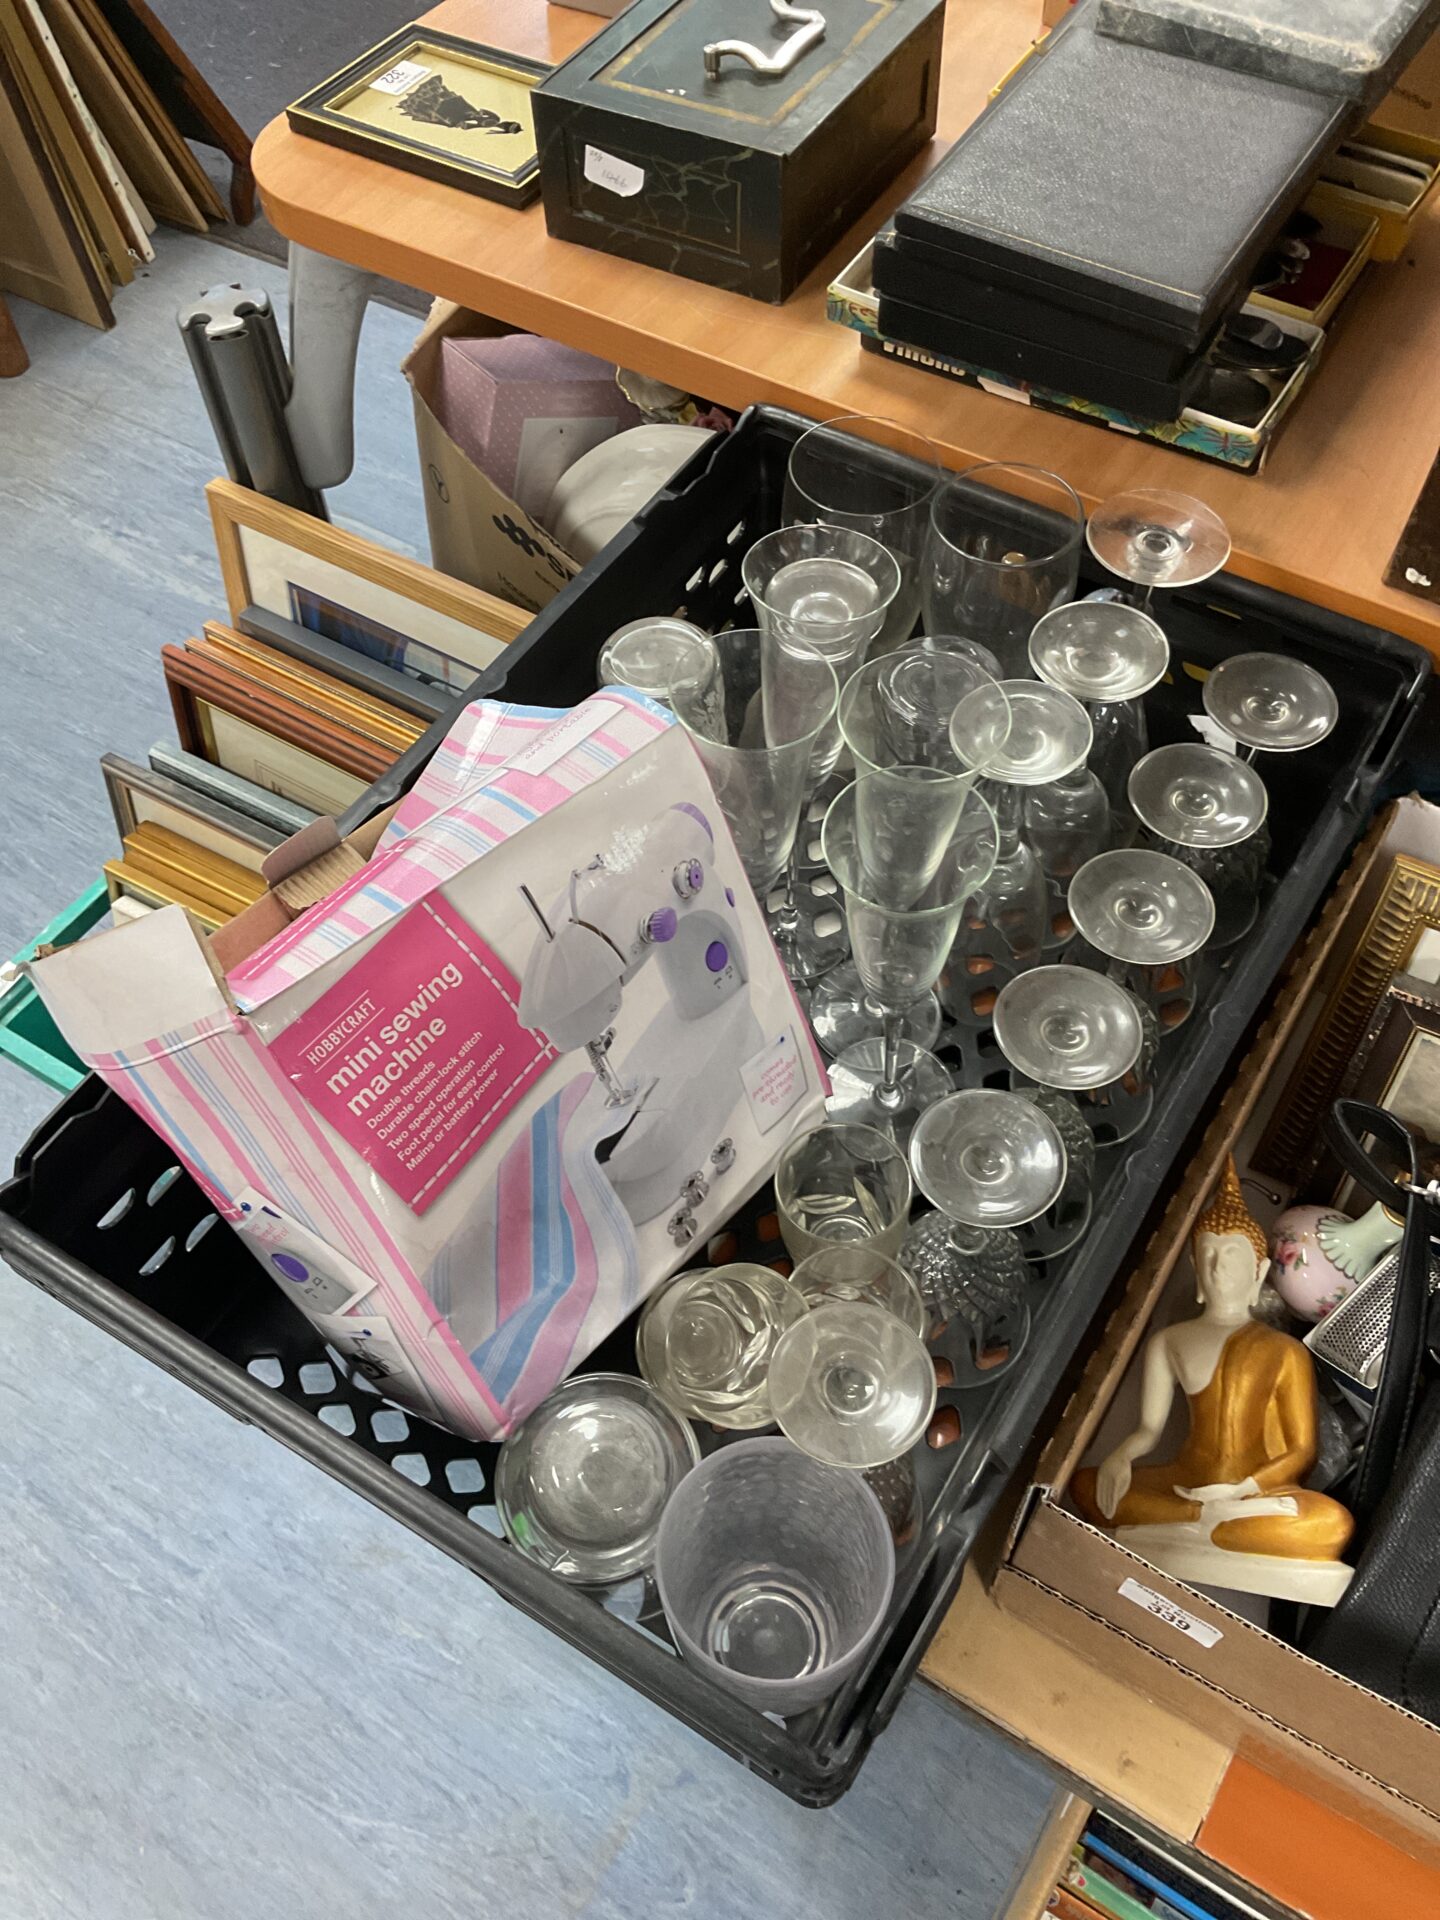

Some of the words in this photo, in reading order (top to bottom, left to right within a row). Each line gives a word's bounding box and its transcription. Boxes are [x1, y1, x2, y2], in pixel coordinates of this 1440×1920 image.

[380, 69, 405, 84] 322
[548, 706, 592, 743] portable
[306, 997, 375, 1065] HOBBYCRAFT
[326, 1036, 383, 1094] mini
[379, 962, 463, 1044] sewing
[347, 1018, 446, 1116] machine
[366, 1095, 402, 1129] Double
[400, 1061, 436, 1095] threads
[376, 1103, 414, 1140] Durable
[414, 1057, 459, 1104] chain-lock
[458, 1031, 483, 1058] stitch
[386, 1130, 409, 1150] Two
[408, 1100, 436, 1131] speed
[436, 1059, 476, 1102] operation
[397, 1136, 421, 1161] Foot
[419, 1111, 446, 1140] pedal
[443, 1097, 458, 1113] for
[457, 1076, 478, 1099] easy
[476, 1044, 505, 1077] control
[406, 1140, 436, 1171] Mains
[434, 1129, 446, 1142] or
[444, 1097, 474, 1131] battery
[473, 1068, 498, 1100] power
[1146, 1604, 1192, 1632] 339
